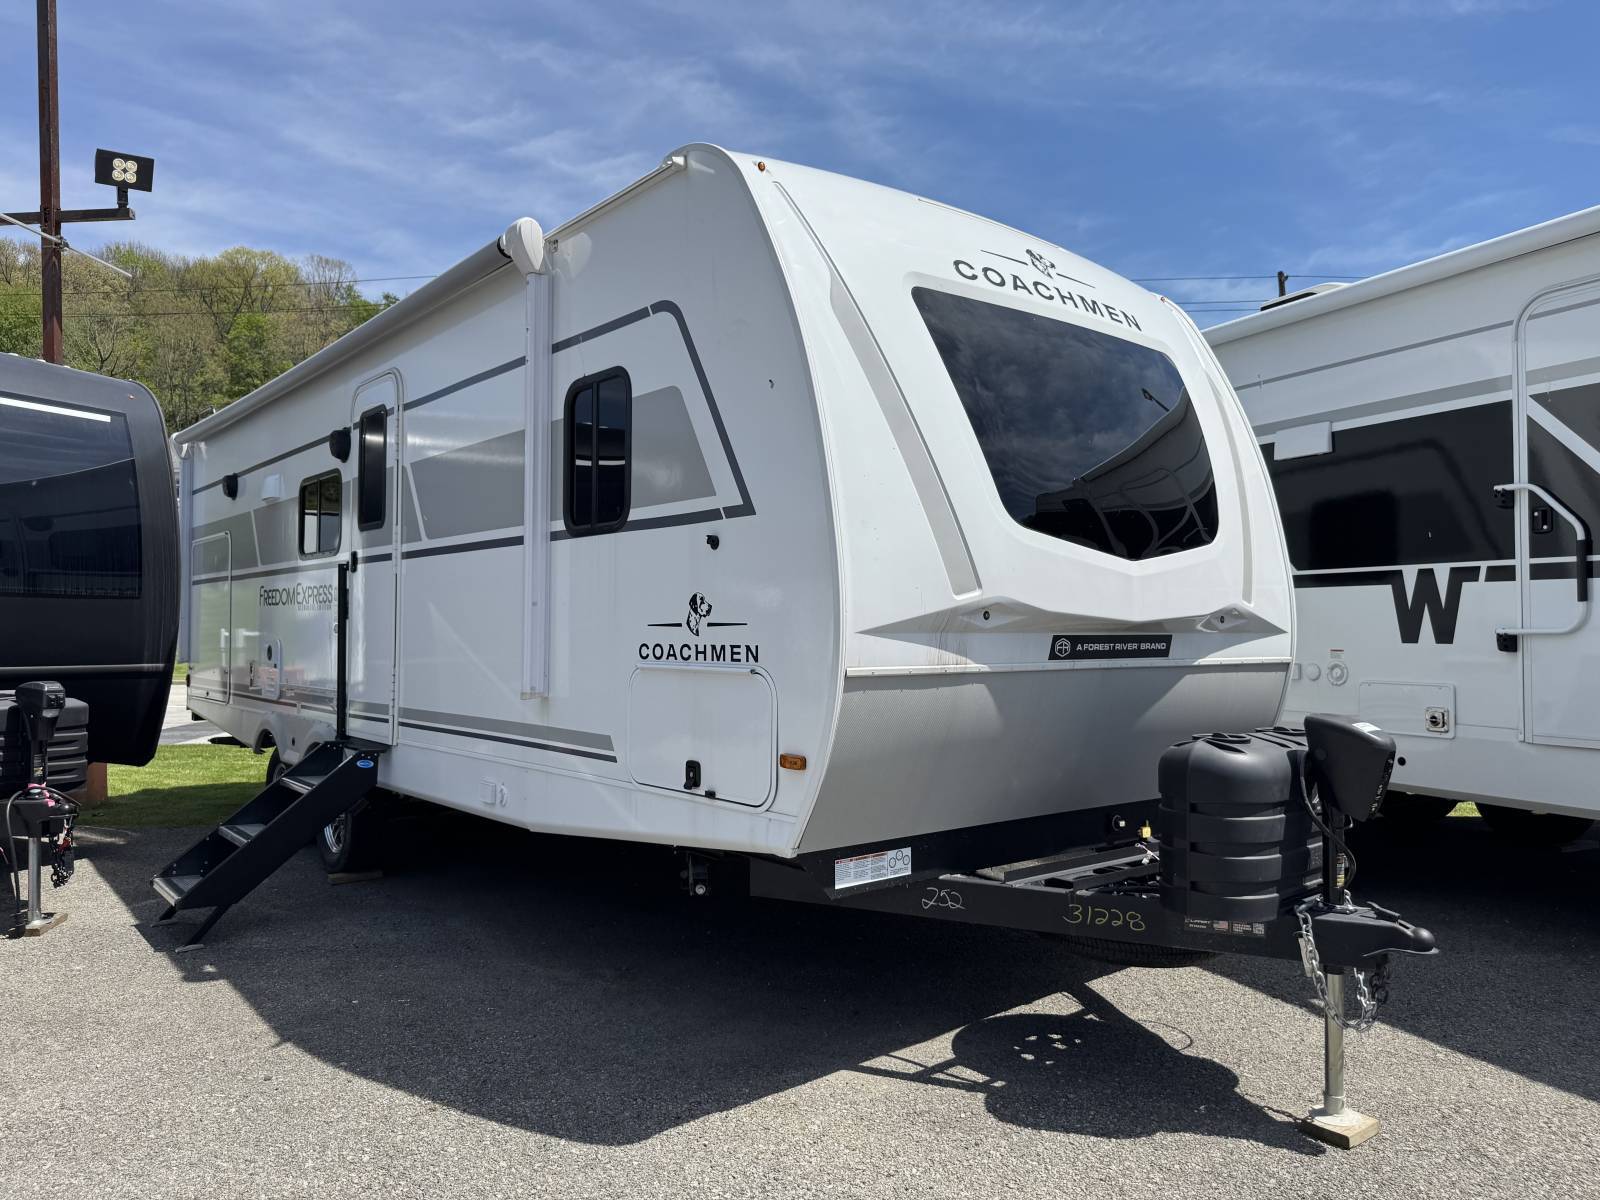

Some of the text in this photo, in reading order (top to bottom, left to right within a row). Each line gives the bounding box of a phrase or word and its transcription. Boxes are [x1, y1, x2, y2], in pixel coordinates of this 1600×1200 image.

[953, 260, 1142, 332] COACHMEN
[638, 642, 759, 663] COACHMEN
[1076, 643, 1083, 651] A
[1083, 643, 1115, 651] FOREST
[1140, 642, 1167, 650] BRAND
[1062, 904, 1146, 931] 31228
